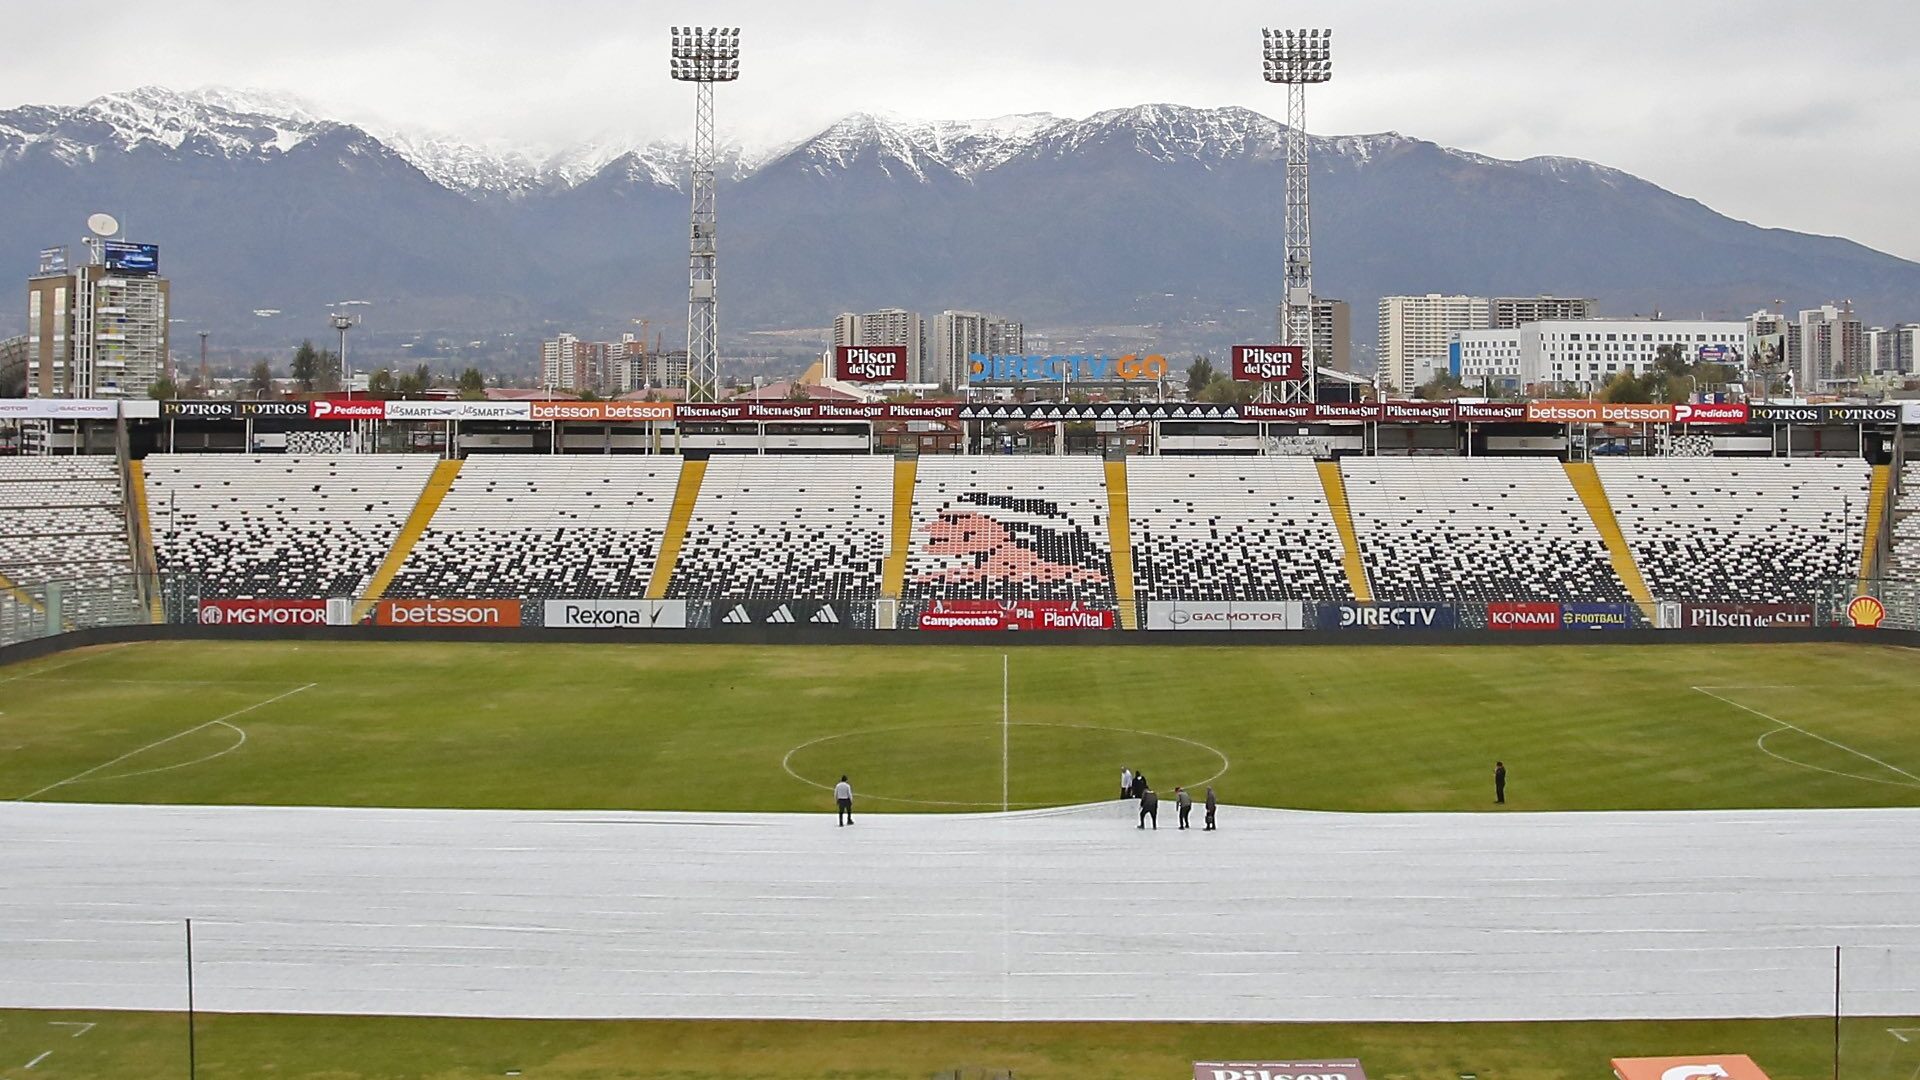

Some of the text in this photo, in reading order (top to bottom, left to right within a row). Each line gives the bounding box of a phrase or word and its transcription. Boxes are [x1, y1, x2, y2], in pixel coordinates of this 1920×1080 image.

[847, 349, 896, 364] Pilsen
[1242, 348, 1292, 364] Pilsen
[849, 364, 894, 379] del Sur
[969, 353, 1168, 382] DIRECTV GO
[1244, 363, 1290, 379] del Sur
[165, 404, 232, 414] POTROS
[242, 404, 307, 414] POTROS
[334, 405, 383, 415] PedidosYa
[533, 404, 599, 418] betsson
[605, 405, 671, 418] betsson
[676, 405, 741, 417] Pilsen del Sur
[748, 405, 813, 417] Pilsen del Sur
[819, 405, 883, 417] Pilsen del Sur
[890, 405, 954, 417] Pilsen del Sur
[1244, 405, 1308, 417] Pilsen del Sur
[1315, 405, 1380, 417] Pilsen del Sur
[1387, 405, 1451, 417] Pilsen del Sur
[1459, 405, 1524, 417] Pilsen del Sur
[1529, 406, 1596, 419] betsson
[1602, 406, 1670, 420] betsson
[1694, 408, 1744, 418] PedidosYa
[1752, 409, 1818, 419] POTROS
[1829, 409, 1896, 419] POTROS
[227, 609, 256, 623] MG
[259, 609, 327, 623] MOTOR
[391, 603, 499, 623] betsson
[566, 605, 640, 624] Rexona
[1044, 611, 1103, 627] PlanVital
[1192, 613, 1282, 621] GAC MOTOR
[1339, 606, 1436, 626] DIRECTV
[1492, 612, 1555, 624] KONAMI
[1691, 608, 1750, 627] Pilsen
[922, 615, 998, 629] Campeonato
